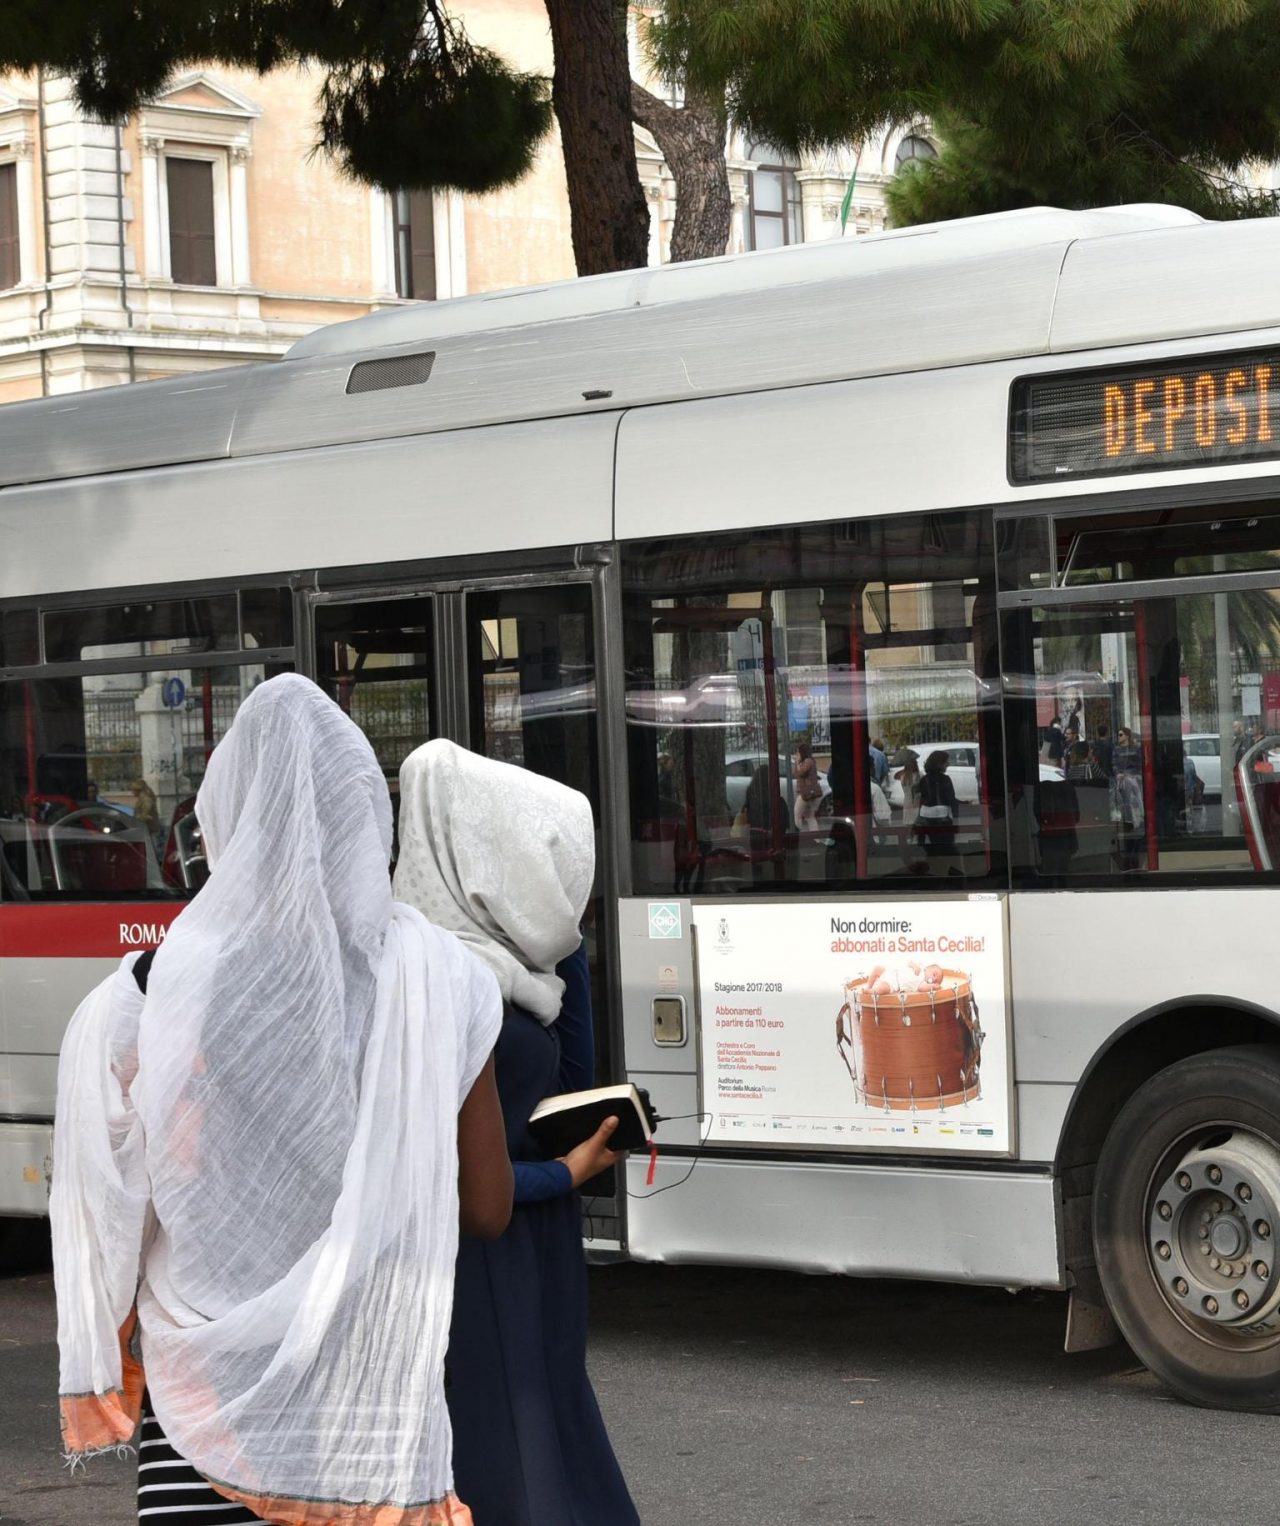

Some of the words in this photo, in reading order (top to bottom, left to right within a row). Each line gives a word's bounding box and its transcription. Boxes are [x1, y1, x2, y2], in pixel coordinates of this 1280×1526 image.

[830, 917, 856, 934] Non
[858, 917, 912, 934] dormire:
[119, 922, 166, 945] ROMA
[830, 936, 886, 953] abbonati
[888, 939, 896, 953] a
[898, 936, 936, 953] Santa
[938, 935, 985, 953] Cecilia!
[714, 982, 745, 994] Stagione
[715, 1005, 762, 1016] Abbonamenti
[721, 1018, 744, 1029] partire
[745, 1018, 754, 1028] da
[755, 1018, 766, 1028] 110
[767, 1020, 784, 1028] euro
